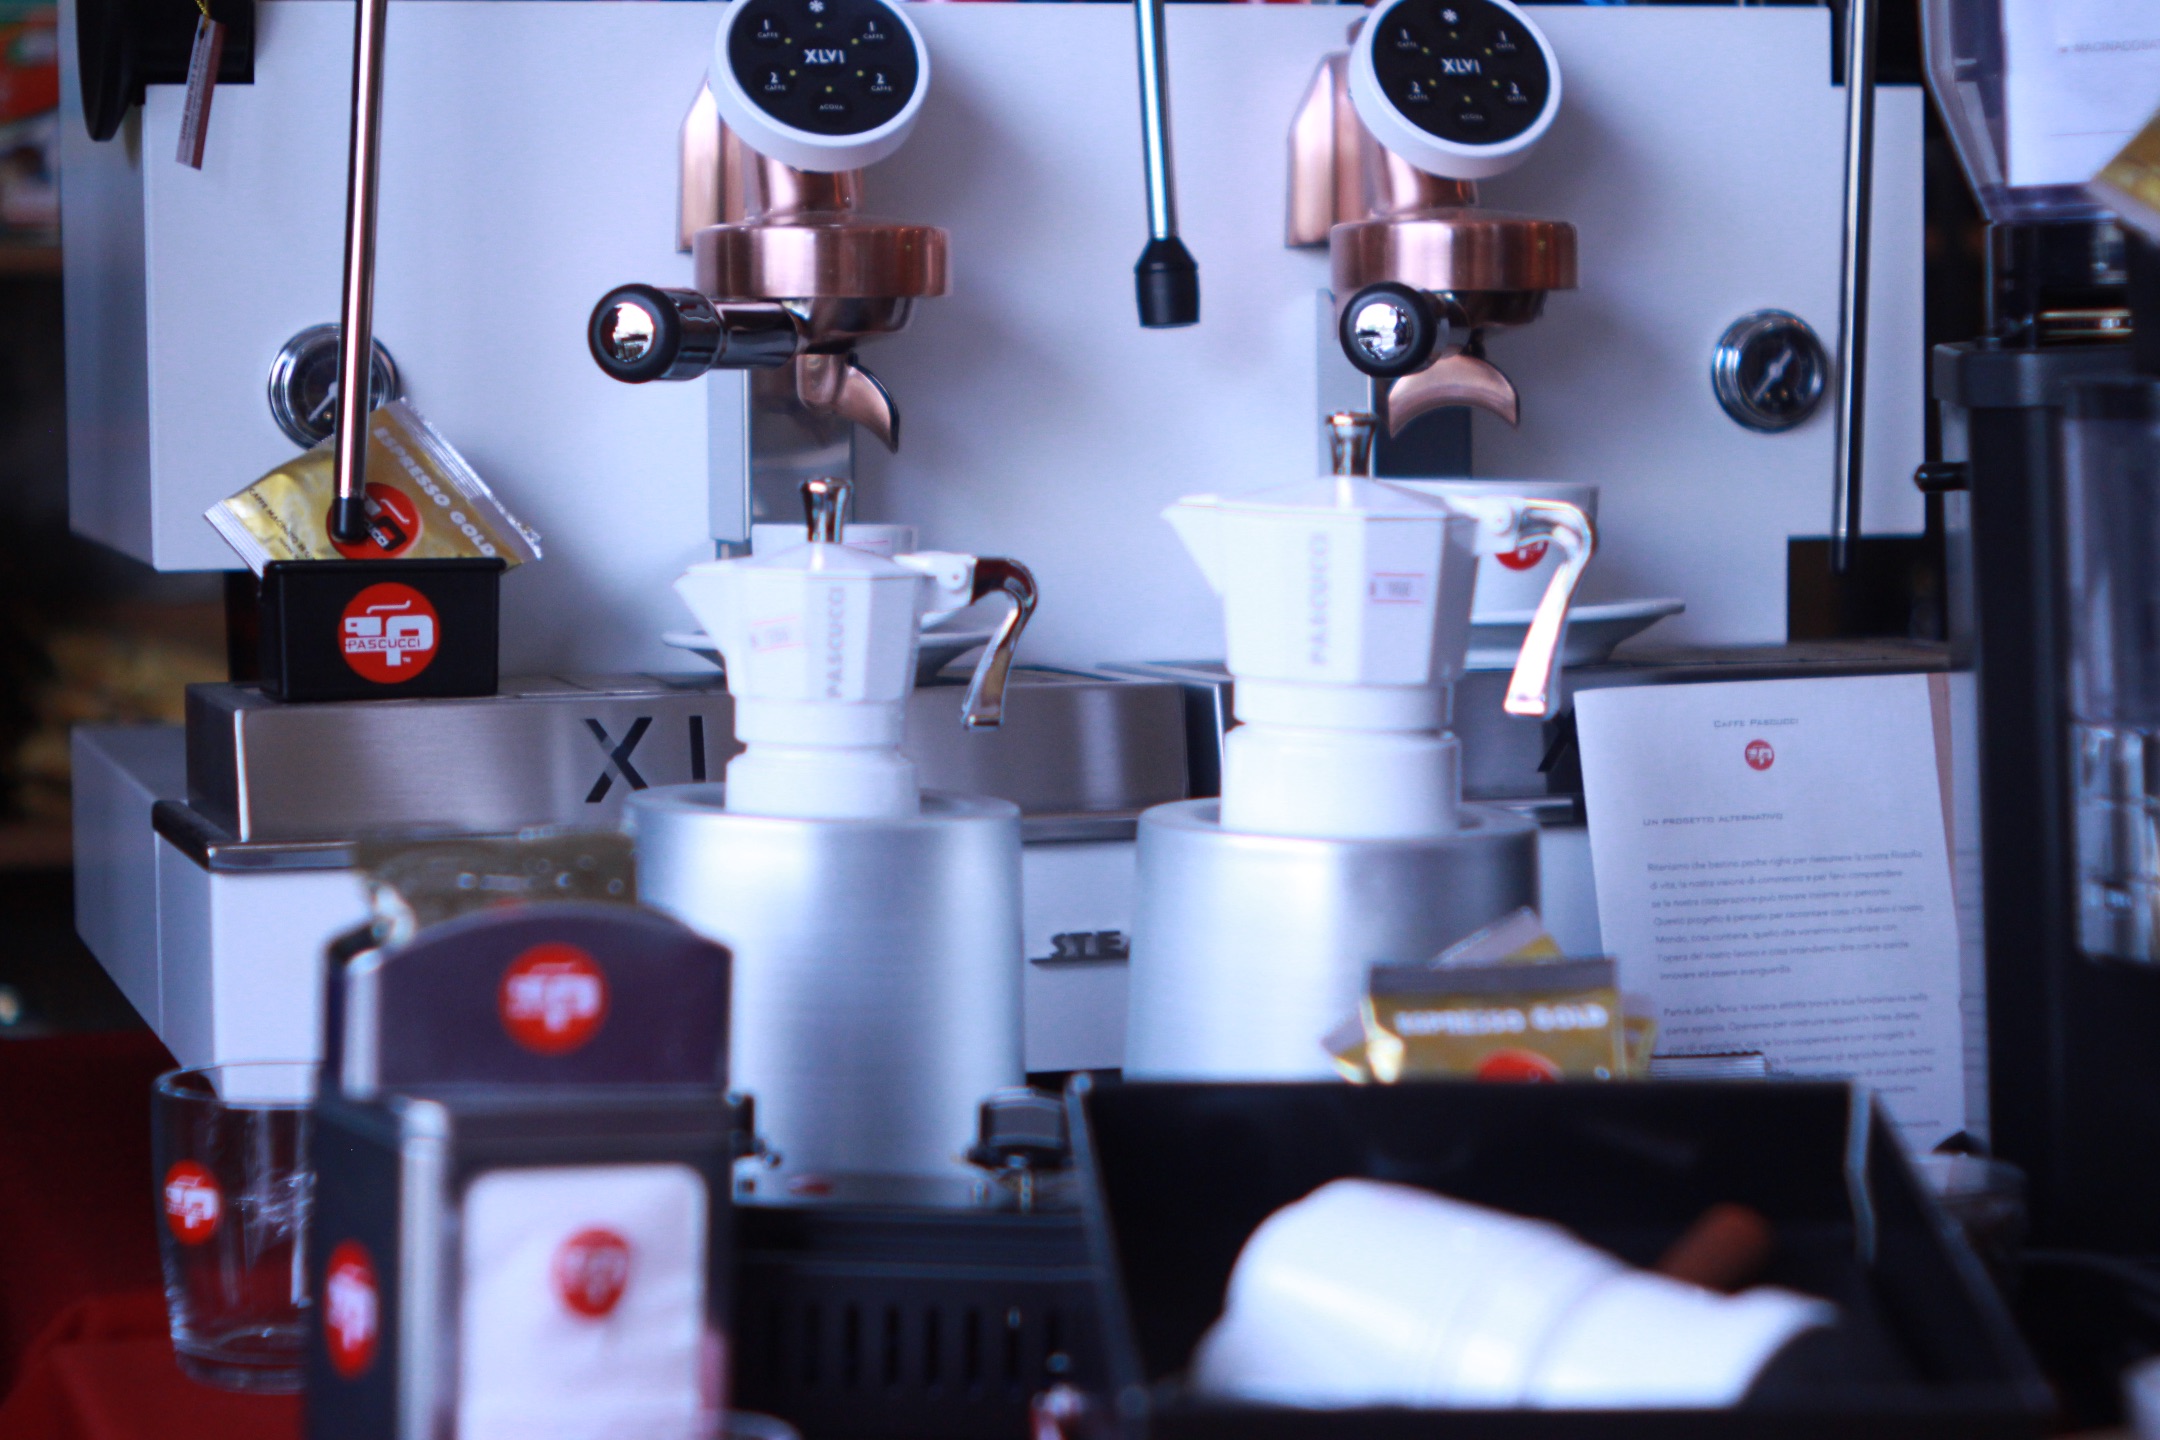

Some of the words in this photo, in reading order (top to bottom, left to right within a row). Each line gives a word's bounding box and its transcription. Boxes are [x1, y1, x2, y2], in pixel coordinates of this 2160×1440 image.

[804, 49, 845, 64] XLVI
[1442, 58, 1481, 74] XLVI
[770, 72, 778, 83] 2
[877, 73, 885, 84] 2
[1412, 81, 1420, 92] 2
[1511, 82, 1519, 94] 2
[373, 427, 450, 508] ESPRESSO
[448, 510, 496, 558] GOLD
[346, 638, 420, 650] PASCUCCI
[826, 586, 845, 699] PASCUCCI
[1047, 930, 1129, 961] STE
